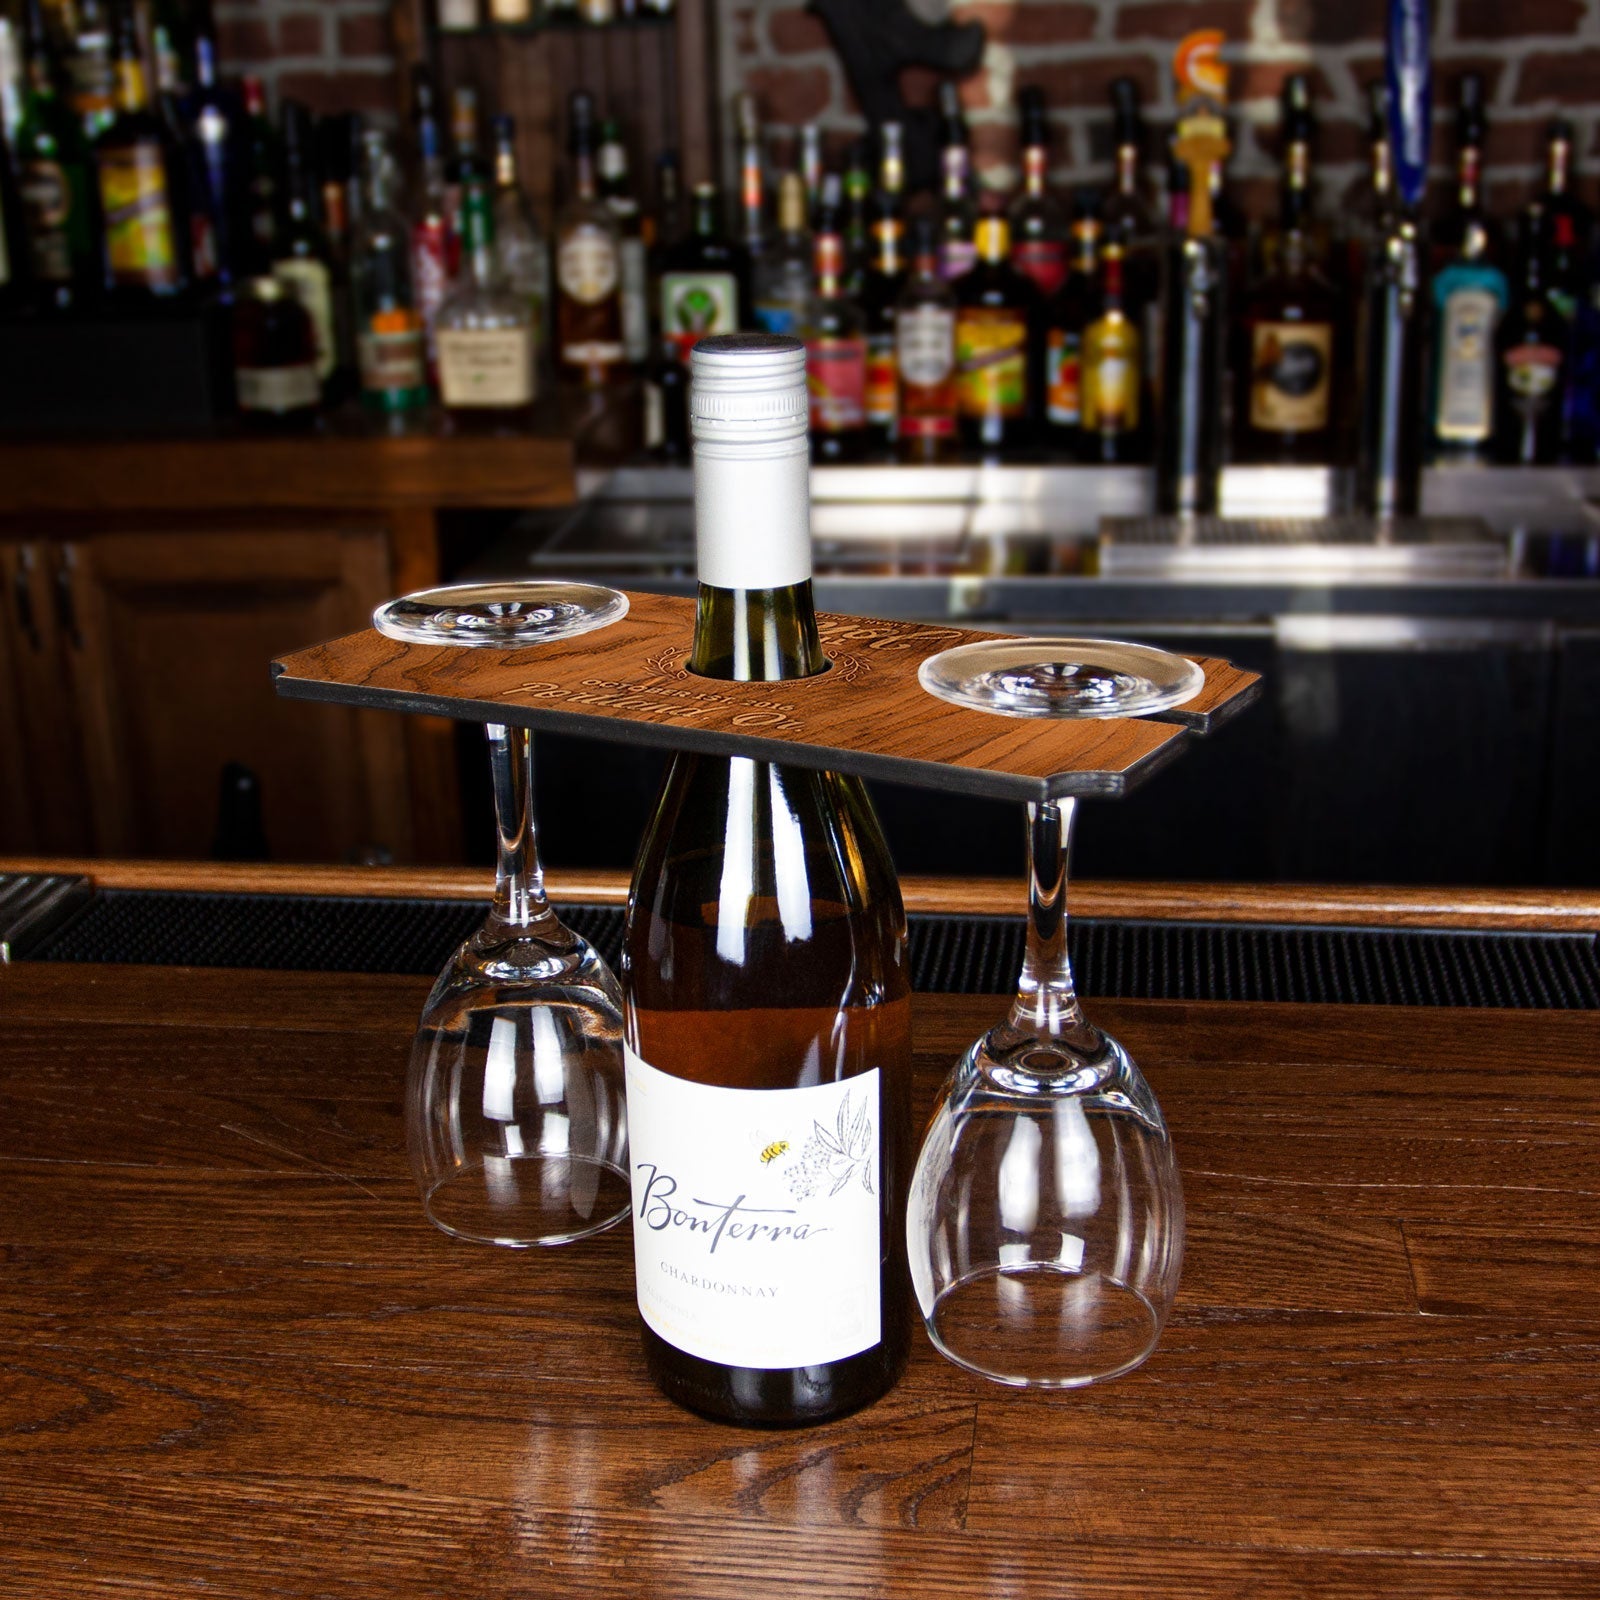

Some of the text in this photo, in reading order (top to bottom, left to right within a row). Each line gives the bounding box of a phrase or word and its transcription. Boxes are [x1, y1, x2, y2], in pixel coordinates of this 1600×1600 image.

[582, 679, 692, 698] OCTOBER
[740, 699, 796, 712] 2016
[636, 1162, 829, 1254] Bonterra
[659, 1260, 780, 1298] CHARDONNAY
